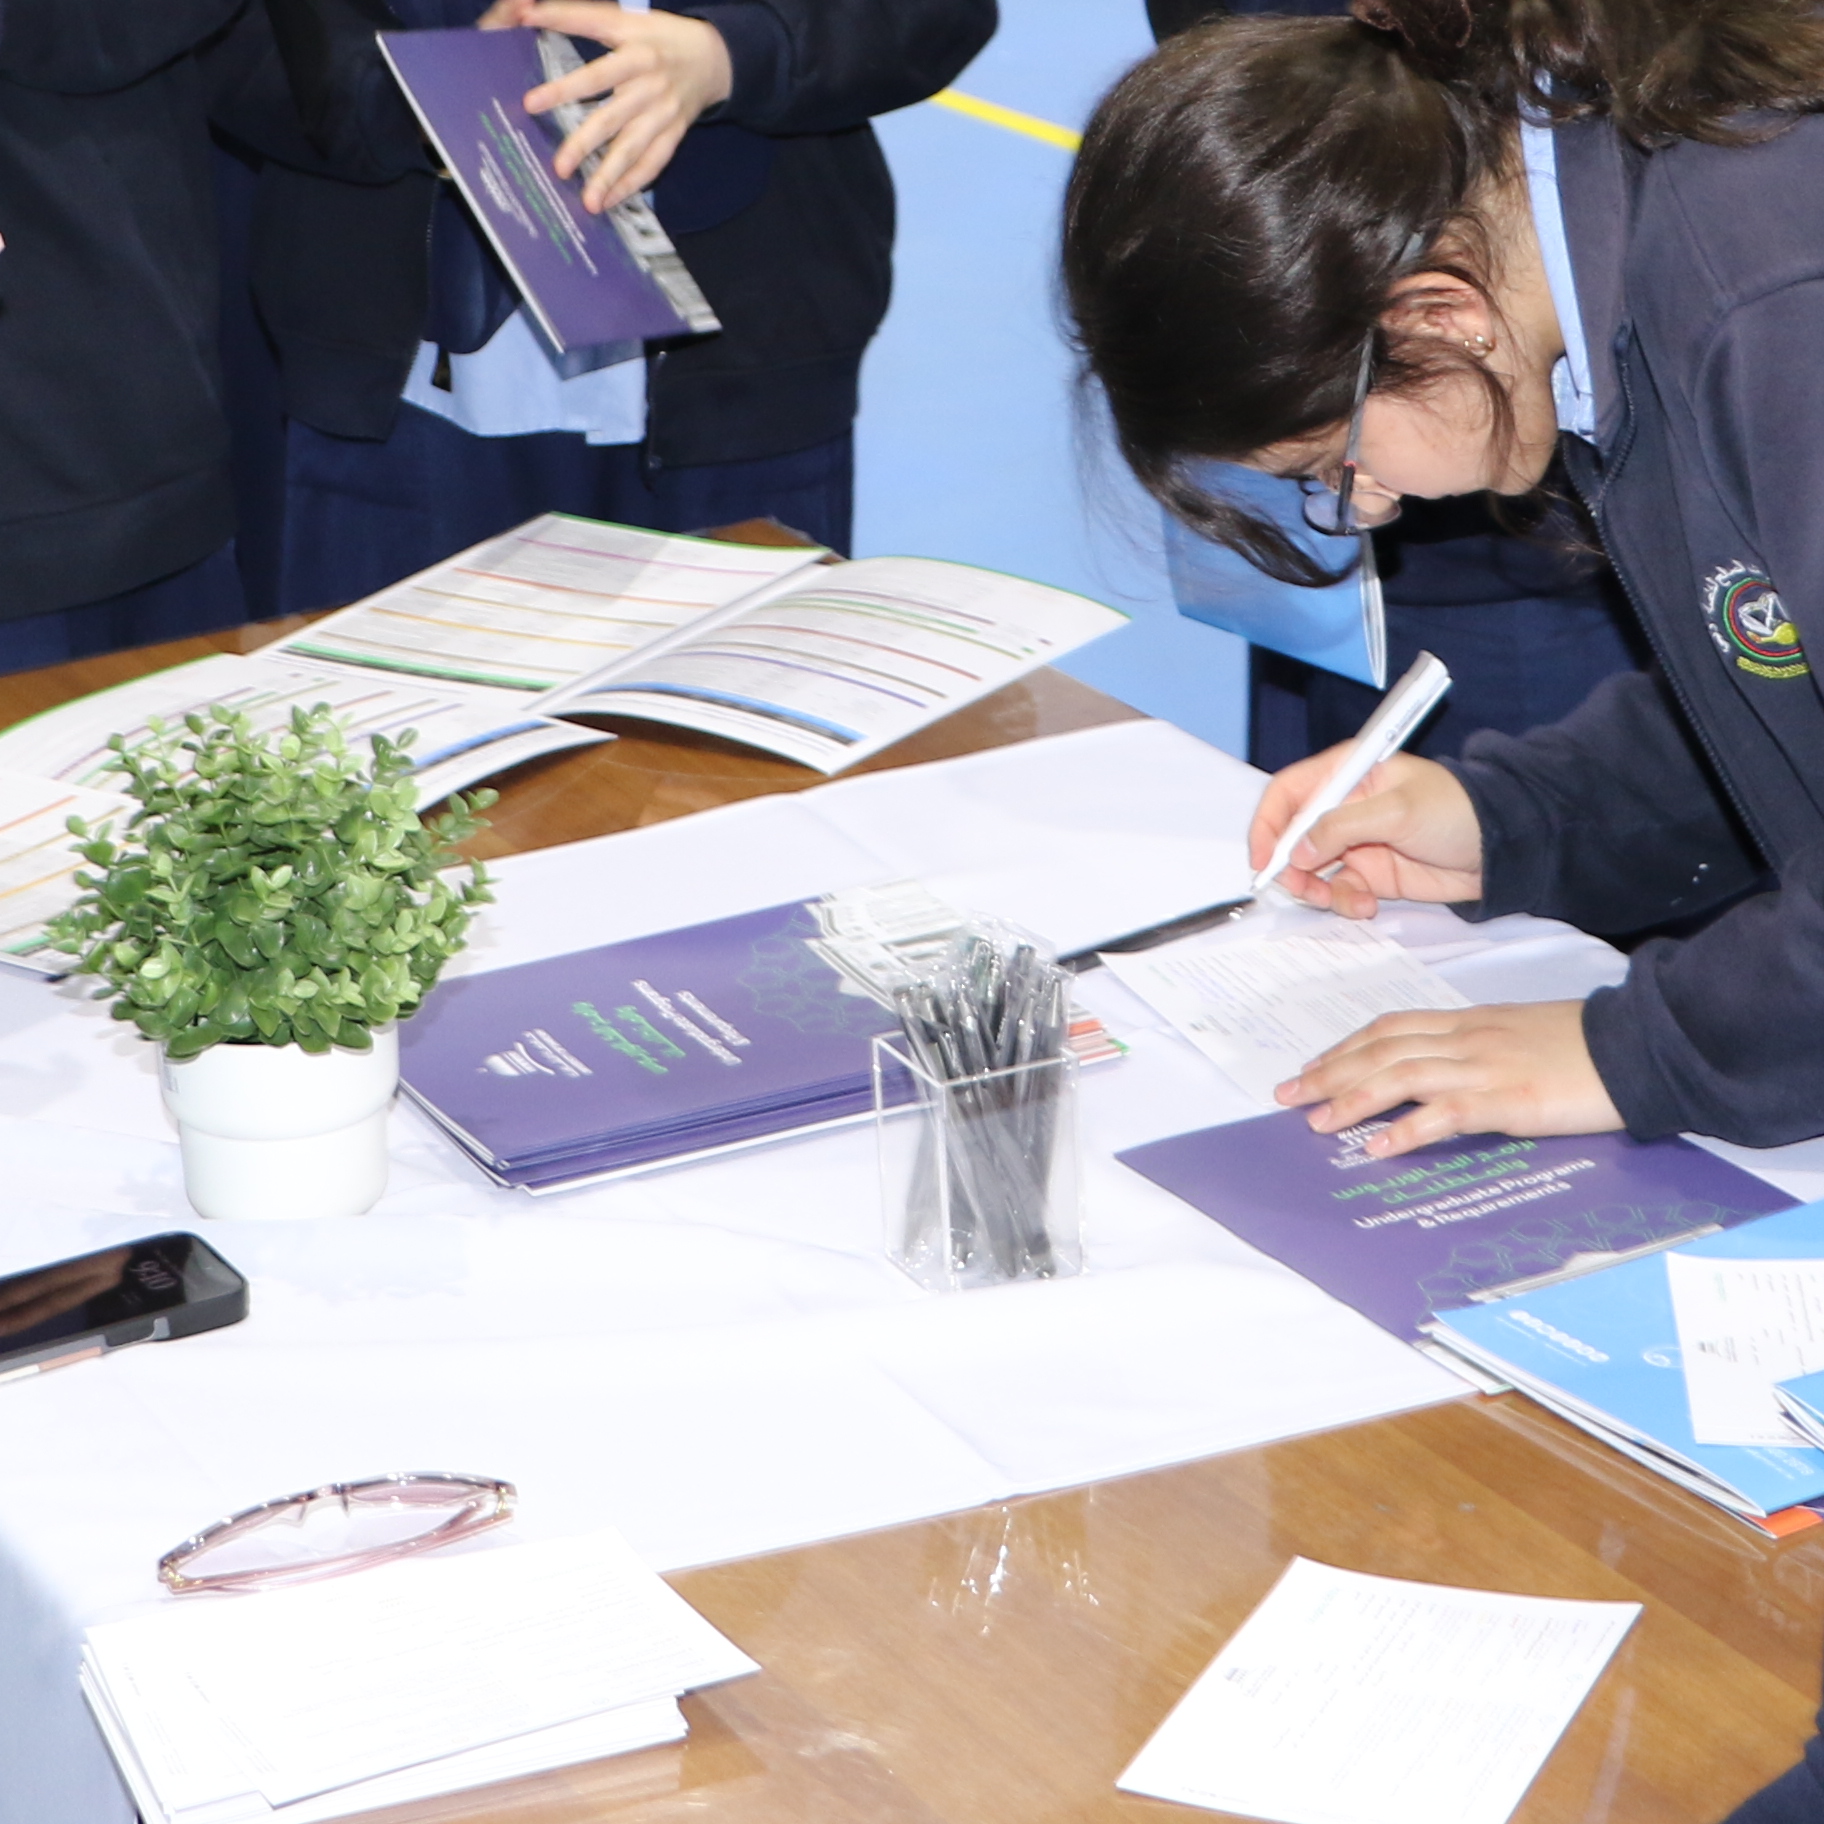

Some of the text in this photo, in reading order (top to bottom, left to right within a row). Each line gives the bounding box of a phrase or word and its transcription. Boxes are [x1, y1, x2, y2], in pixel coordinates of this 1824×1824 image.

[1353, 1157, 1596, 1228] Undergraduate Programs
[1417, 1179, 1572, 1228] & Requirements
